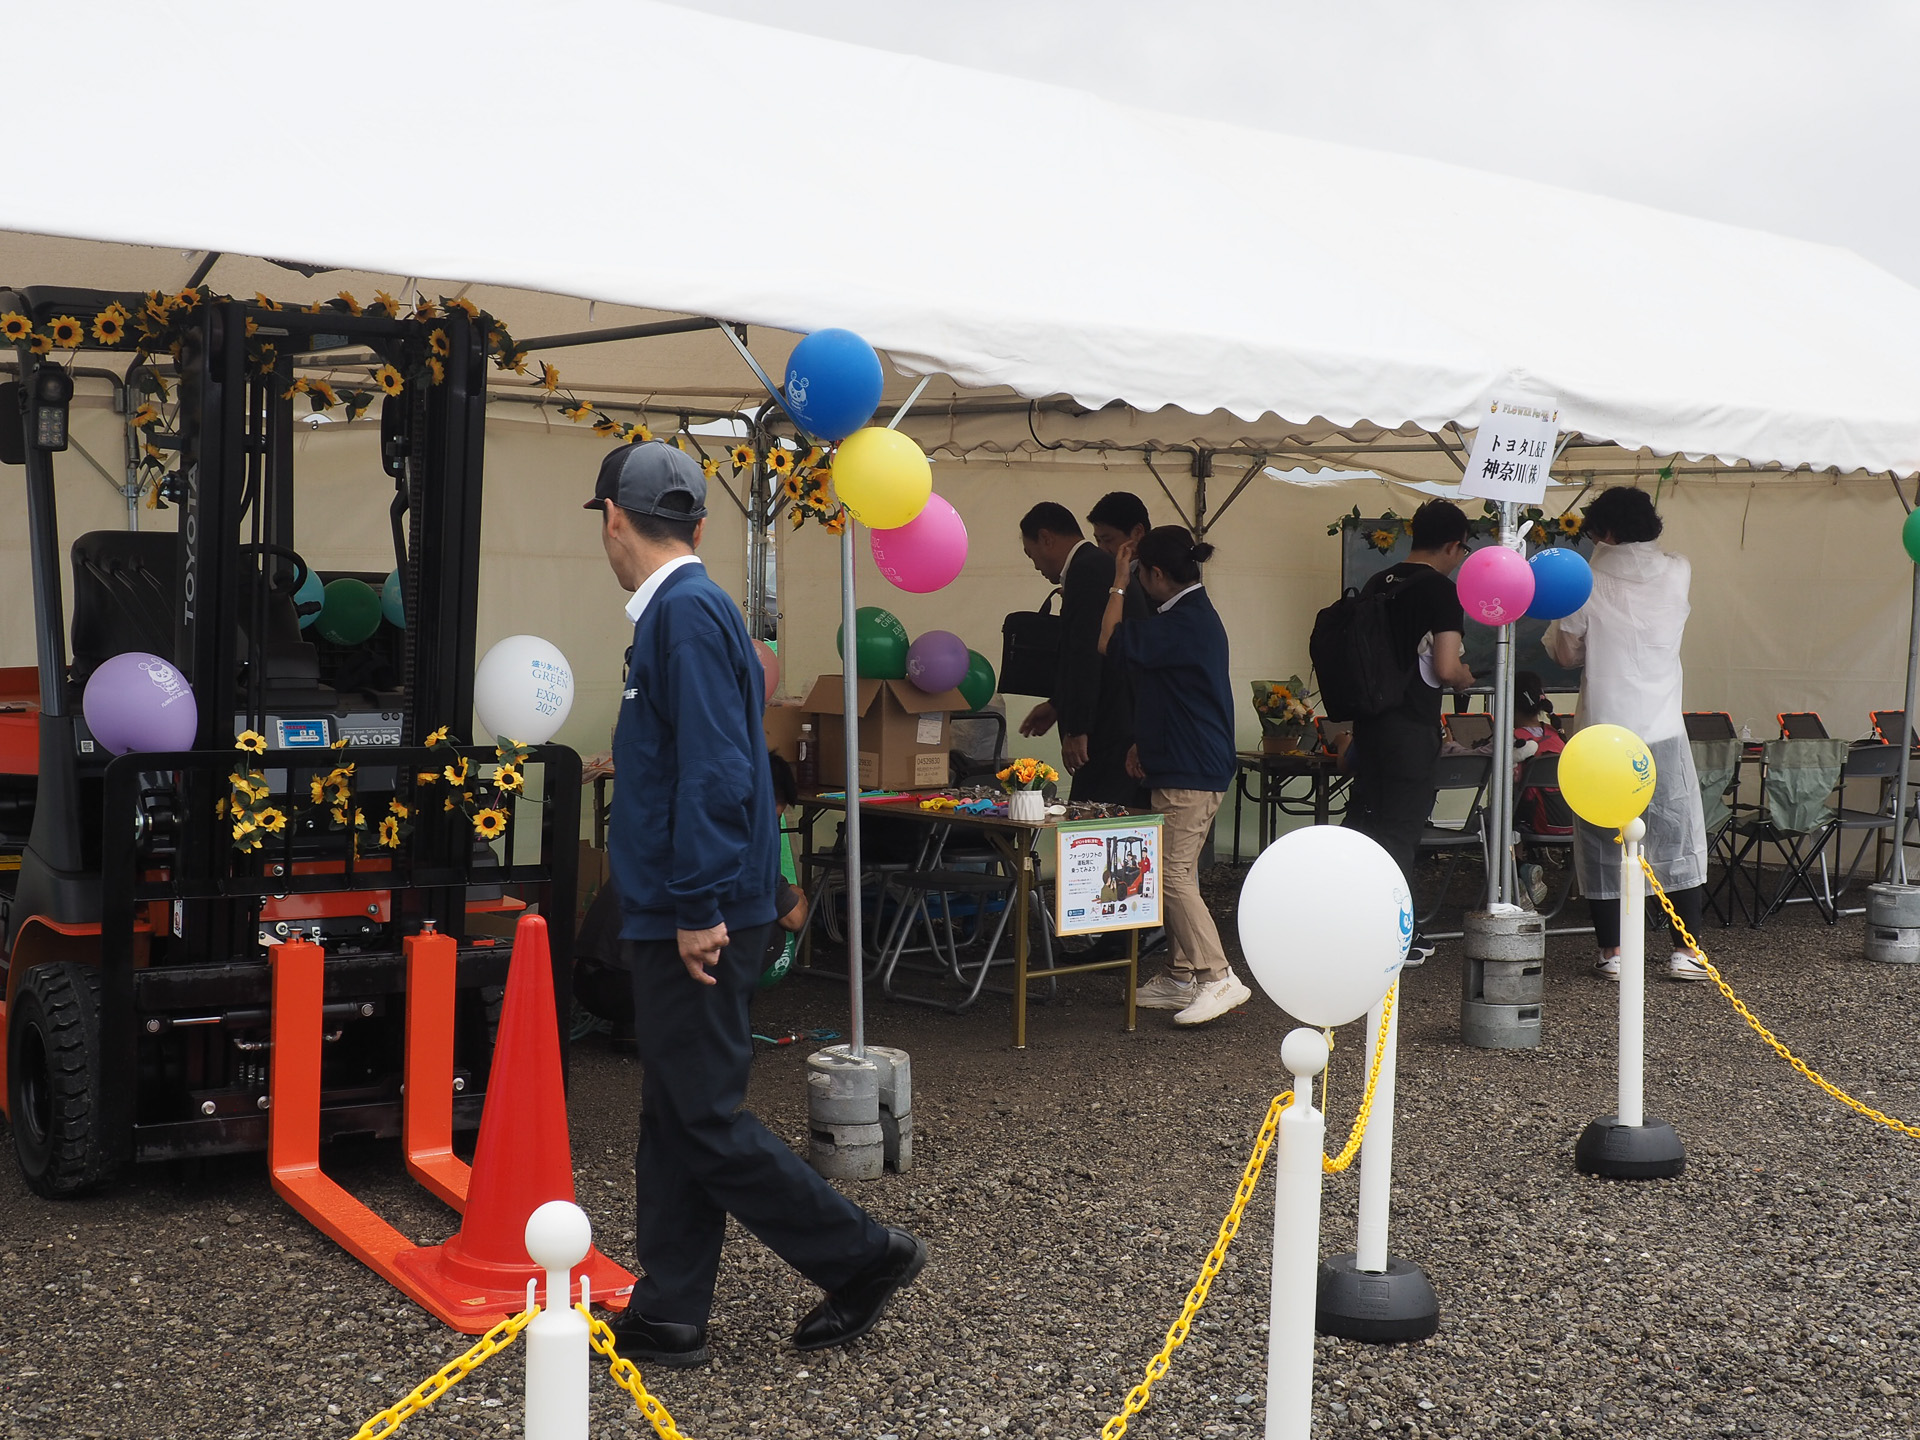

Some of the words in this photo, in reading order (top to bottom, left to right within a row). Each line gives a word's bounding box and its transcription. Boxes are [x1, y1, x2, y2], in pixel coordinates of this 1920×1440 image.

[1491, 434, 1548, 458] トヨタL&F
[1481, 458, 1541, 484] 神奈川(株)
[184, 462, 198, 626] TOYOTA
[532, 669, 568, 689] GREEN
[536, 688, 563, 707] EXPO
[535, 701, 557, 717] 2027
[1214, 982, 1232, 1000] HOKA
